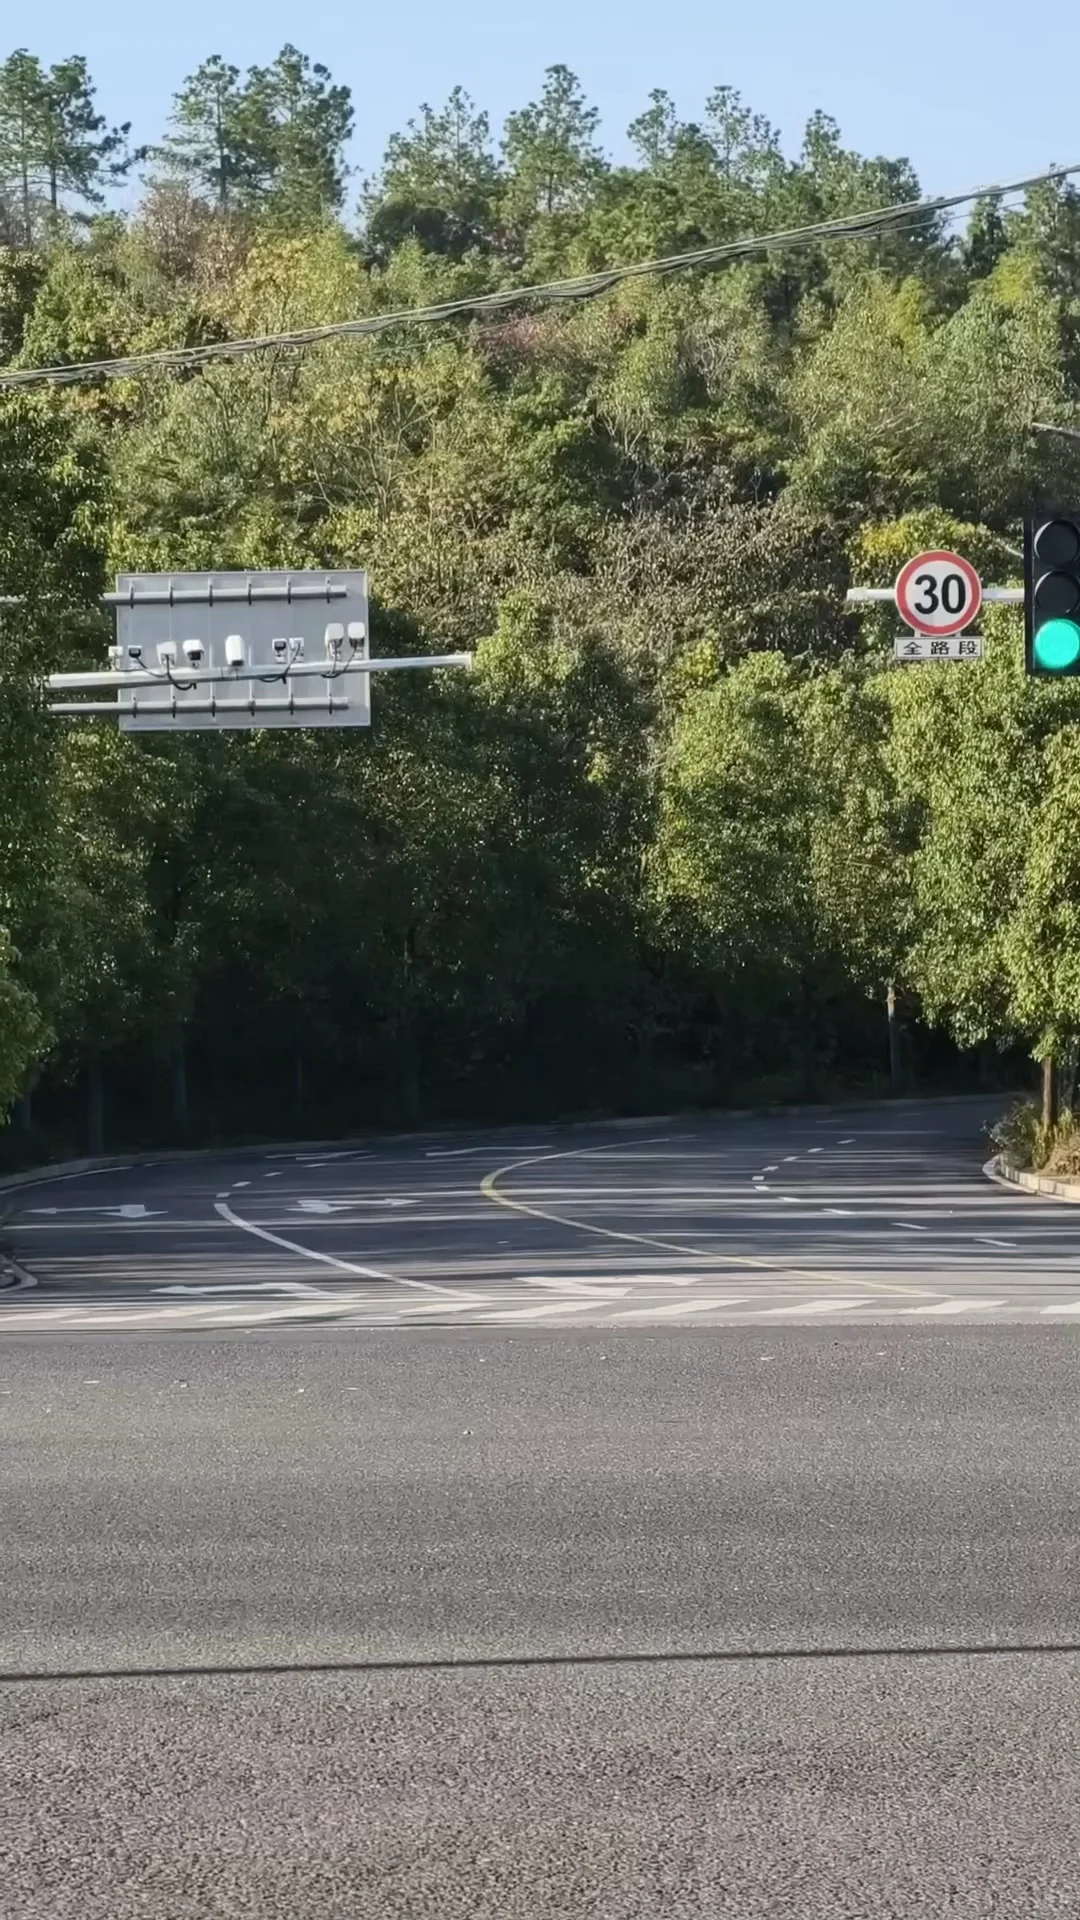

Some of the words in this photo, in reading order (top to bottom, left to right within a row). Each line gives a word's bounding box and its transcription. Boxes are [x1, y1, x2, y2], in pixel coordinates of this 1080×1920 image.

[914, 574, 966, 615] 30
[903, 641, 978, 656] 全路段
